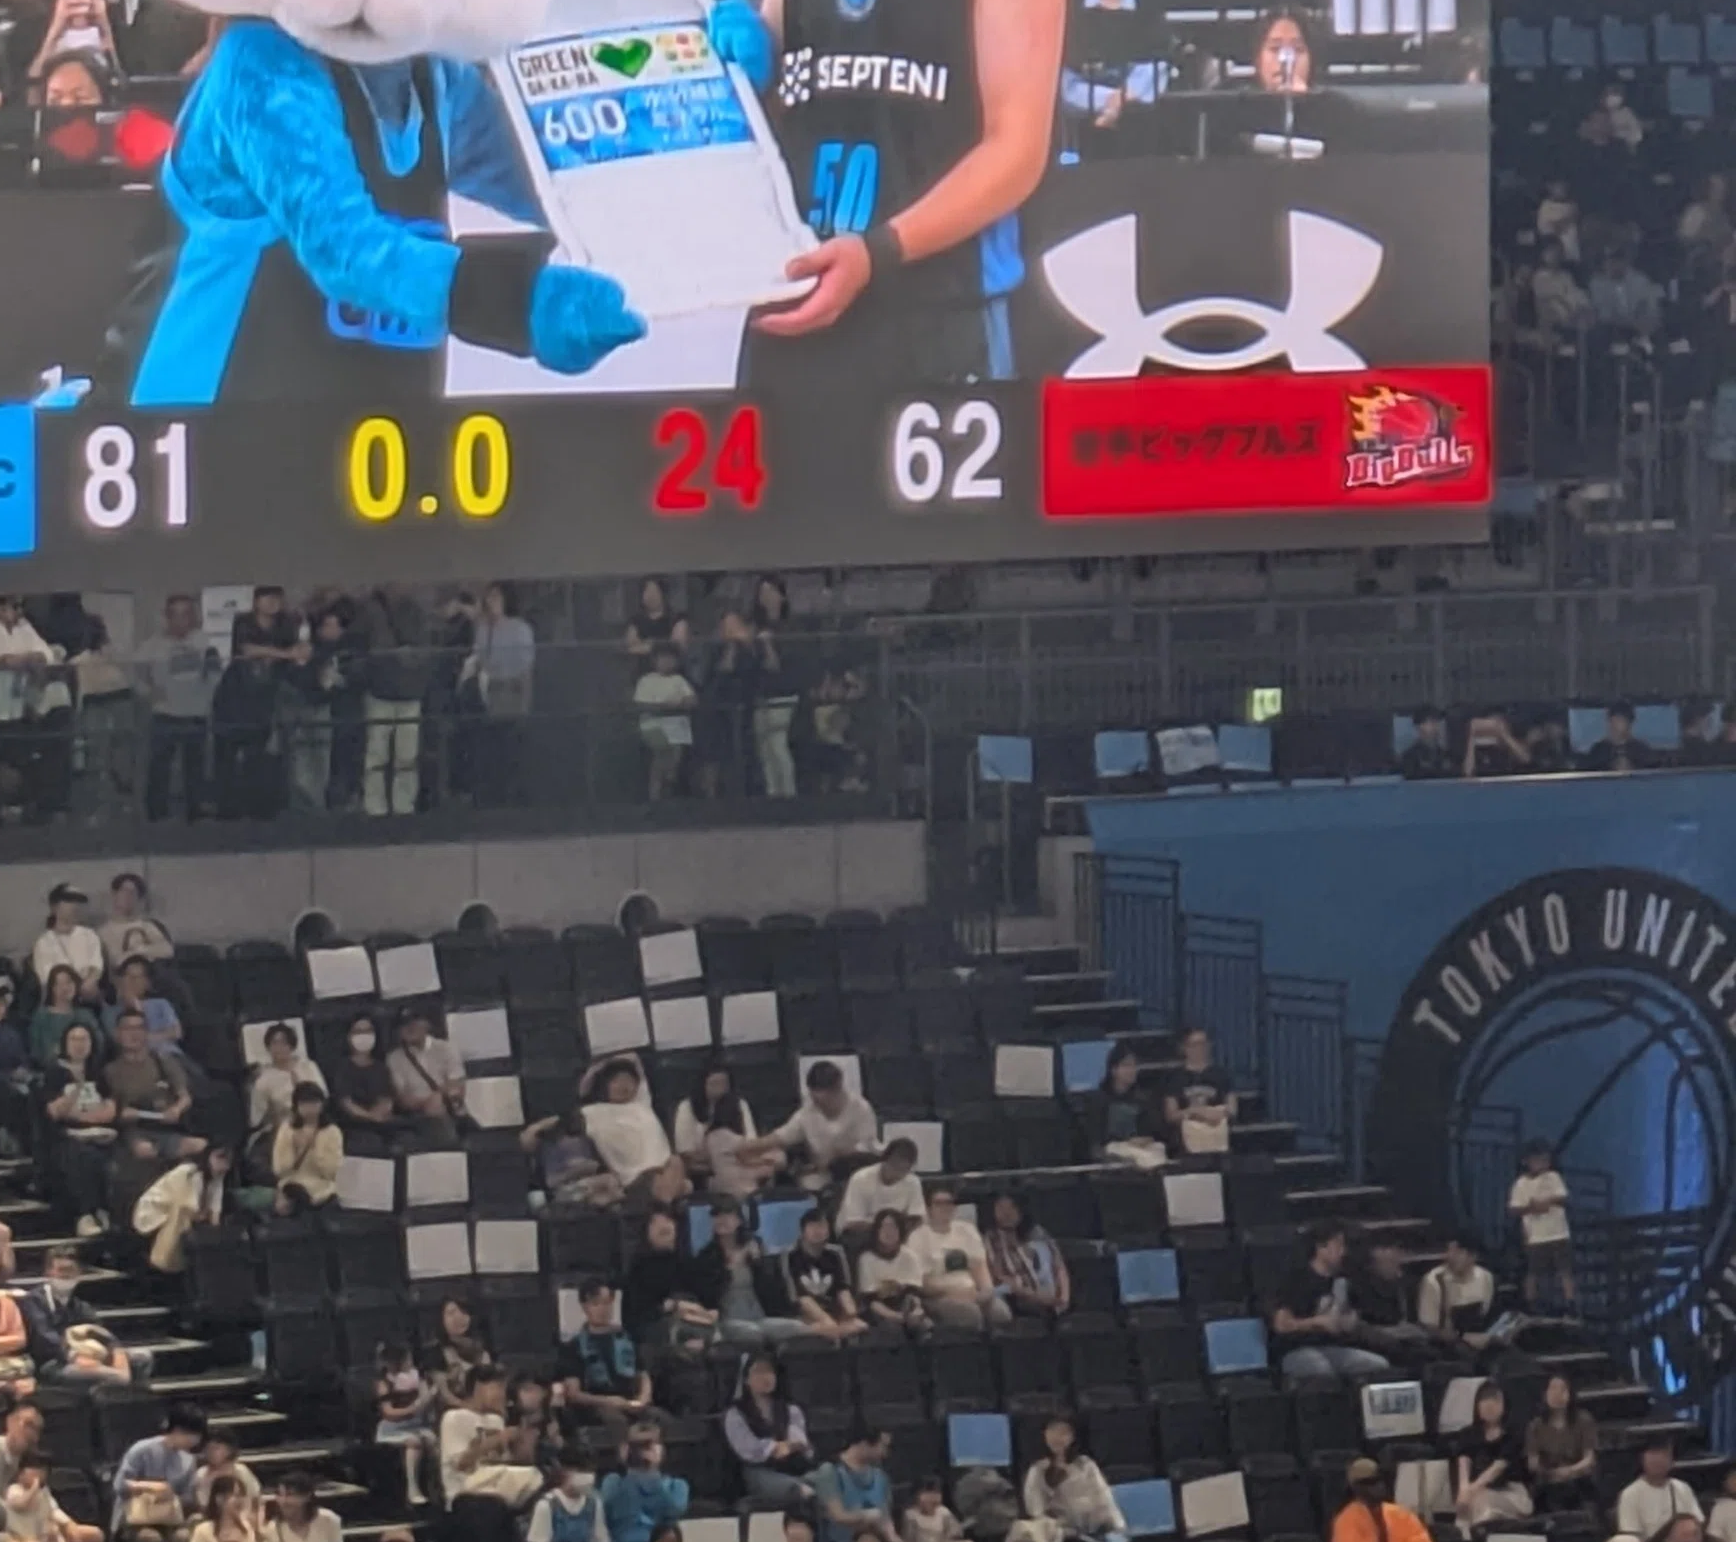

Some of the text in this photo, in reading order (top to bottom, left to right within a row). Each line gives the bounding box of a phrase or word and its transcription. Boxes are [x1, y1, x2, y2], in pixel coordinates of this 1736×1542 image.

[543, 98, 628, 145] 600
[816, 54, 948, 102] SEPTENI
[82, 422, 188, 528] 81
[348, 413, 511, 520] 0.0
[653, 406, 764, 512] 24
[892, 399, 1003, 502] 62
[1414, 888, 1736, 1045] TOKYO UNITE
